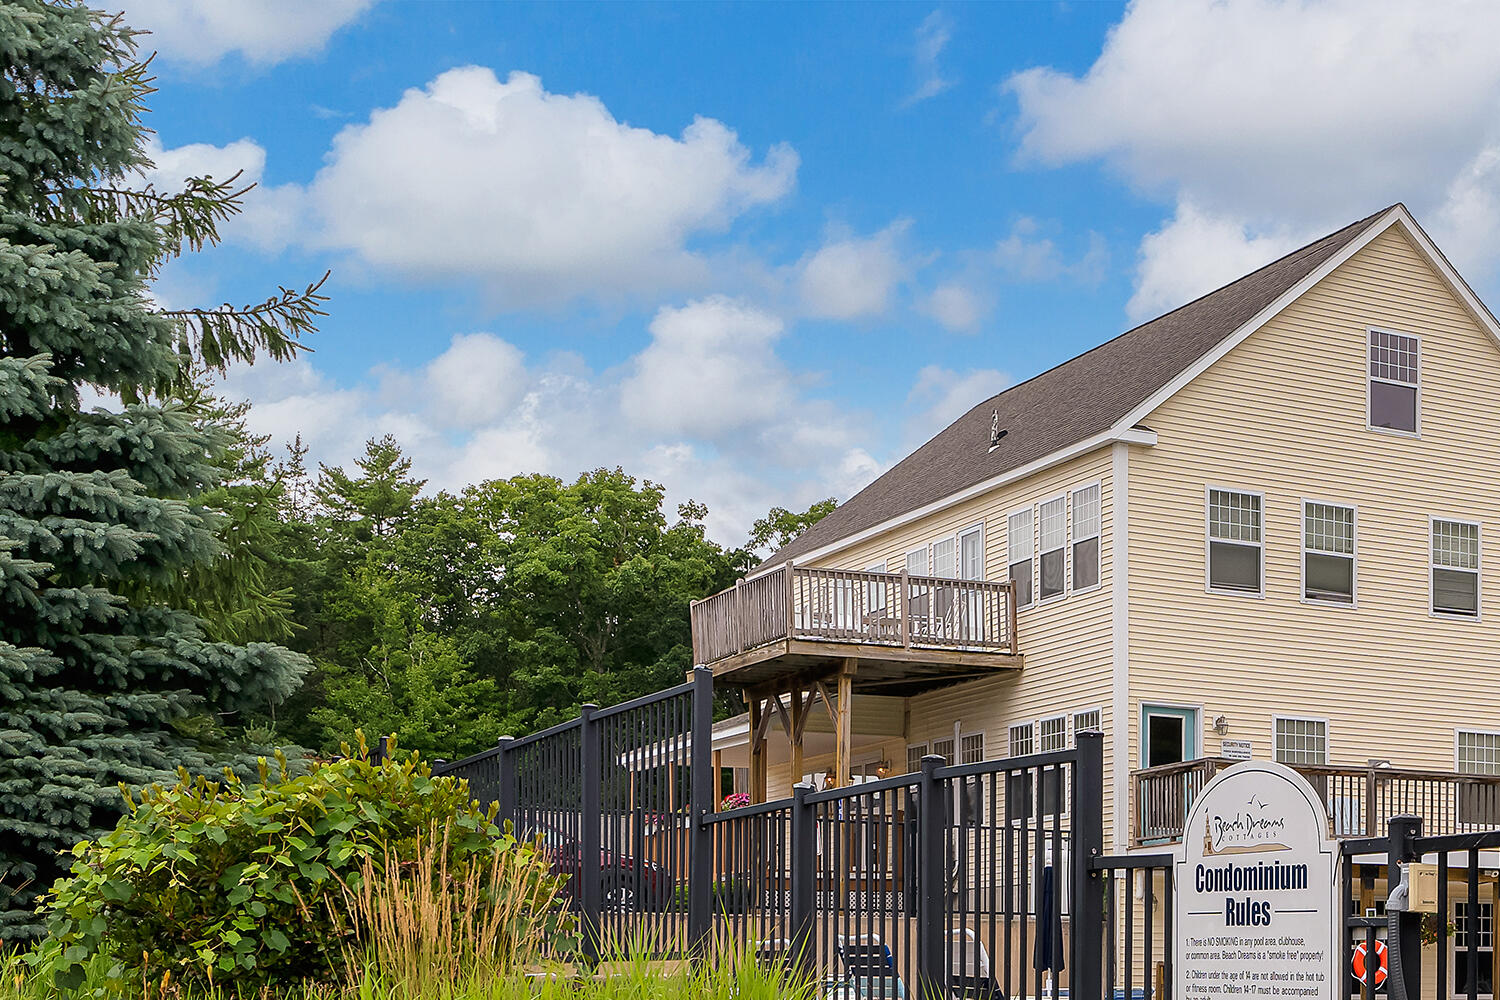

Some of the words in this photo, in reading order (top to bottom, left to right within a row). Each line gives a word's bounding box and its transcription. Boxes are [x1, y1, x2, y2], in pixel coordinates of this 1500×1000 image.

[1214, 812, 1243, 847] Beach
[1246, 813, 1285, 837] Dreams
[1222, 832, 1278, 842] COTTAGES
[1195, 860, 1308, 893] Condominium
[1225, 897, 1271, 926] Rules
[1190, 938, 1202, 946] There
[1216, 937, 1238, 946] SMOKING
[1245, 939, 1253, 948] any
[1254, 937, 1264, 948] pool
[1265, 939, 1277, 947] area,
[1278, 936, 1305, 947] clubhouse,
[1222, 951, 1236, 959] Beach
[1238, 951, 1256, 959] Dreams
[1192, 970, 1207, 979] Children
[1208, 970, 1220, 979] under
[1230, 973, 1238, 981] age
[1260, 972, 1269, 980] not
[1270, 972, 1289, 980] allowed
[1296, 972, 1304, 981] the
[1306, 972, 1314, 981] hot
[1316, 973, 1325, 981] tub
[1223, 985, 1242, 994] Children
[1244, 985, 1256, 994] 14-17
[1258, 986, 1271, 994] must
[1282, 987, 1319, 997] accompanied
